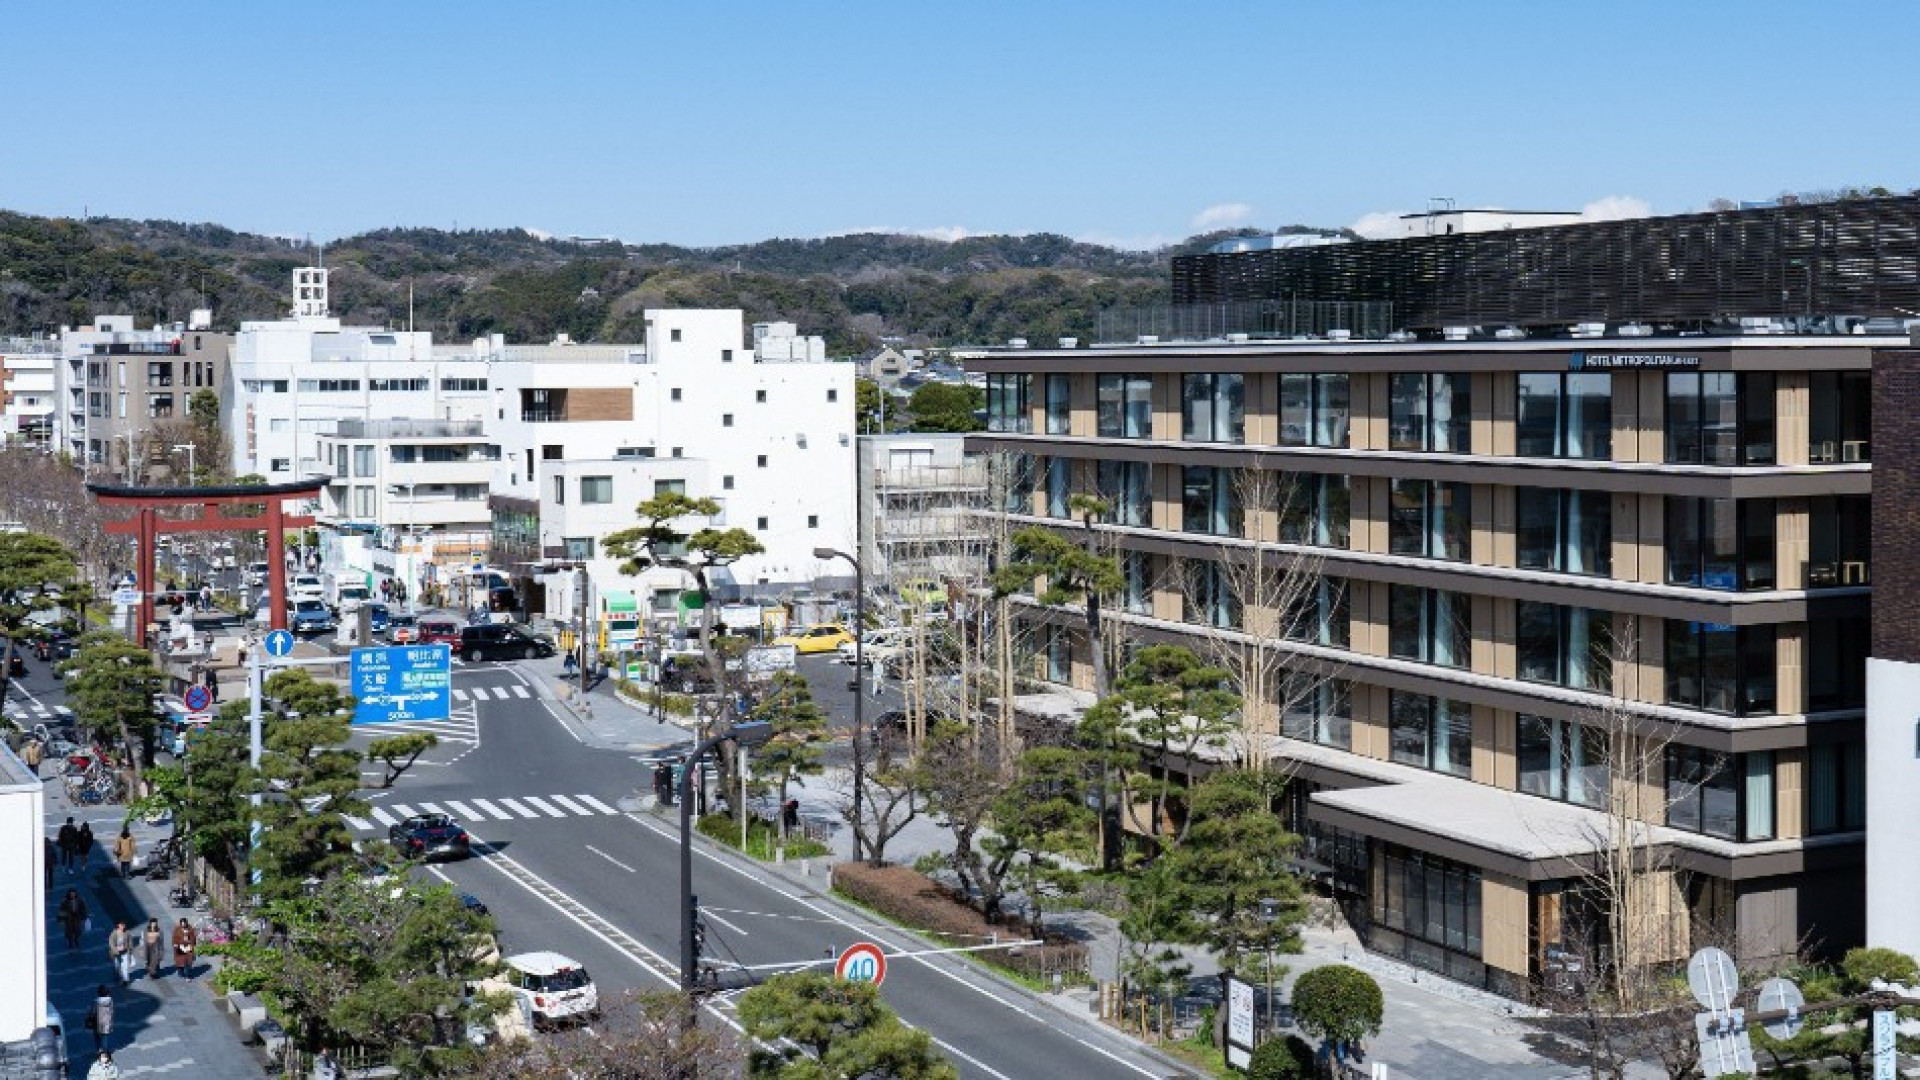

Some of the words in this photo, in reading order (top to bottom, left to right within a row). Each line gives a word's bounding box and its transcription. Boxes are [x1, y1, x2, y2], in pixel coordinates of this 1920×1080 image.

[1586, 355, 1611, 366] HOTEL
[1613, 355, 1673, 365] METROPOLITAN
[849, 958, 873, 981] 40
